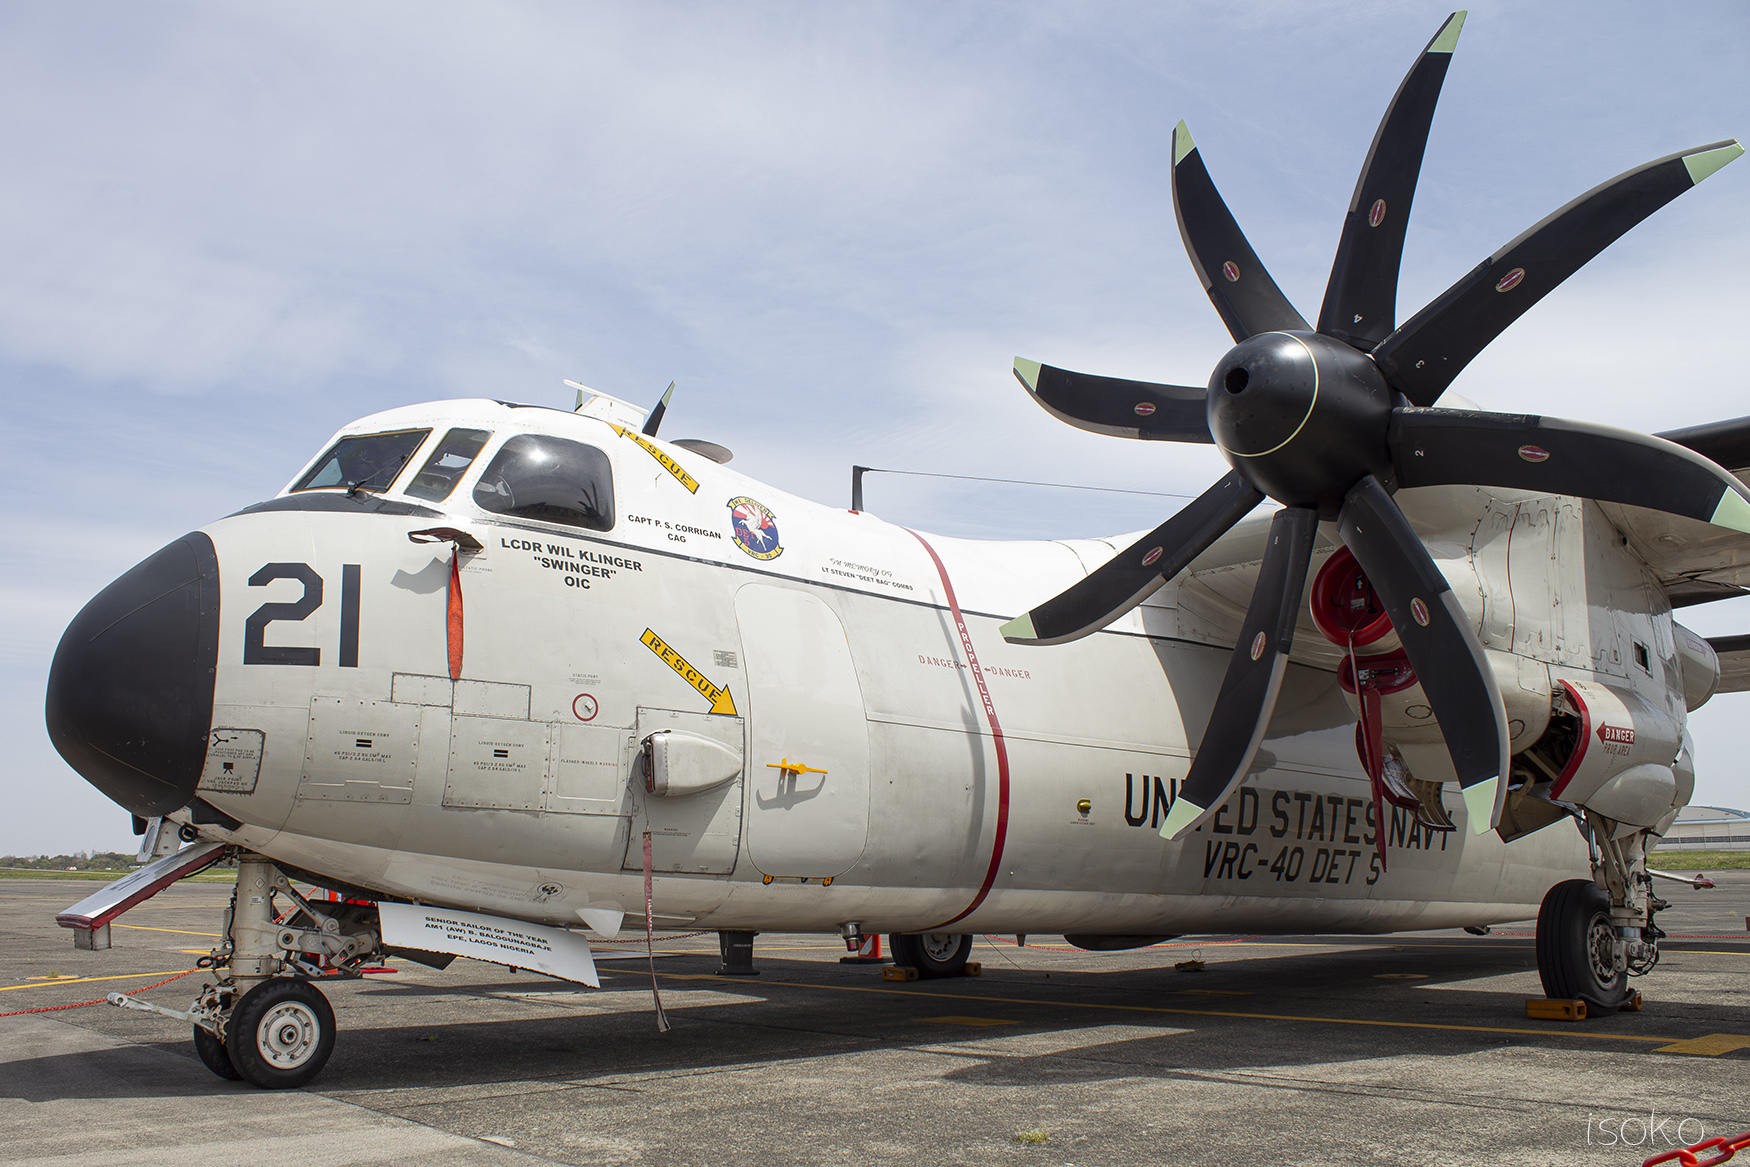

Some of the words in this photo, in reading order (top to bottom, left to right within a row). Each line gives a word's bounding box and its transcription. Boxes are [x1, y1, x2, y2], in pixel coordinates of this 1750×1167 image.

[622, 428, 694, 486] RESCUE
[628, 514, 652, 526] CAPT
[655, 520, 662, 528] P.
[664, 522, 672, 530] S.
[675, 524, 722, 540] CORRIGAN
[668, 534, 686, 542] CAG
[735, 526, 754, 540] DET
[501, 538, 543, 553] LCDR
[546, 544, 574, 558] WIL
[579, 550, 643, 572] KLINGER
[534, 556, 616, 579] "SWINGER"
[831, 568, 856, 578] STEVEN
[564, 576, 590, 589] OIC
[243, 562, 361, 667] 21
[649, 637, 722, 704] RESCUE
[918, 654, 960, 670] DANGER
[958, 622, 994, 715] PROPELLER
[990, 666, 1031, 680] DANGER
[1605, 728, 1635, 742] DANGER
[1270, 790, 1377, 845] STATES
[1203, 840, 1304, 882] VRC-40
[1309, 848, 1361, 884] DET
[1366, 852, 1382, 886] 5
[425, 916, 458, 926] SENIOR
[460, 921, 492, 932] SAILOR
[507, 930, 524, 939] THE
[526, 934, 548, 944] YEAR
[446, 926, 466, 934] (AW)
[447, 934, 467, 942] EPE,
[469, 938, 498, 948] LAGOS
[500, 944, 535, 956] NIGERIA
